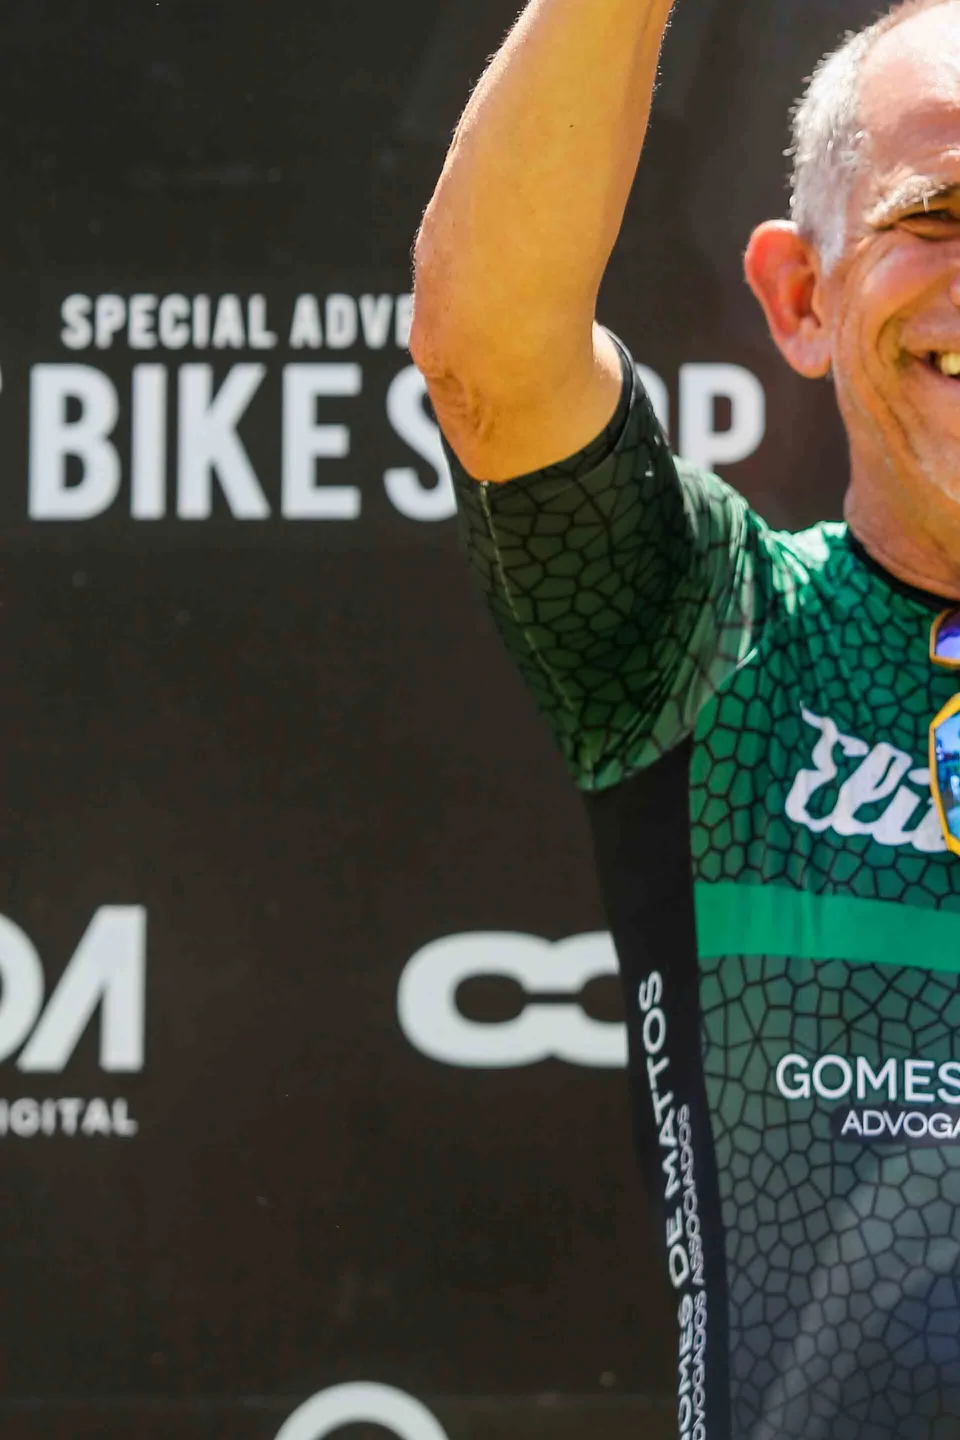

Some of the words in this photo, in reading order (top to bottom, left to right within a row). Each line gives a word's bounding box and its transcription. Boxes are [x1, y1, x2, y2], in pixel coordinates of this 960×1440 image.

[60, 293, 278, 350] SPECIAL
[290, 293, 415, 350] ADVE
[28, 362, 363, 521] BIKE
[785, 700, 952, 853] Eli
[638, 970, 682, 1200] MATTOS
[665, 1204, 691, 1288] DE
[678, 1293, 695, 1440] OMES
